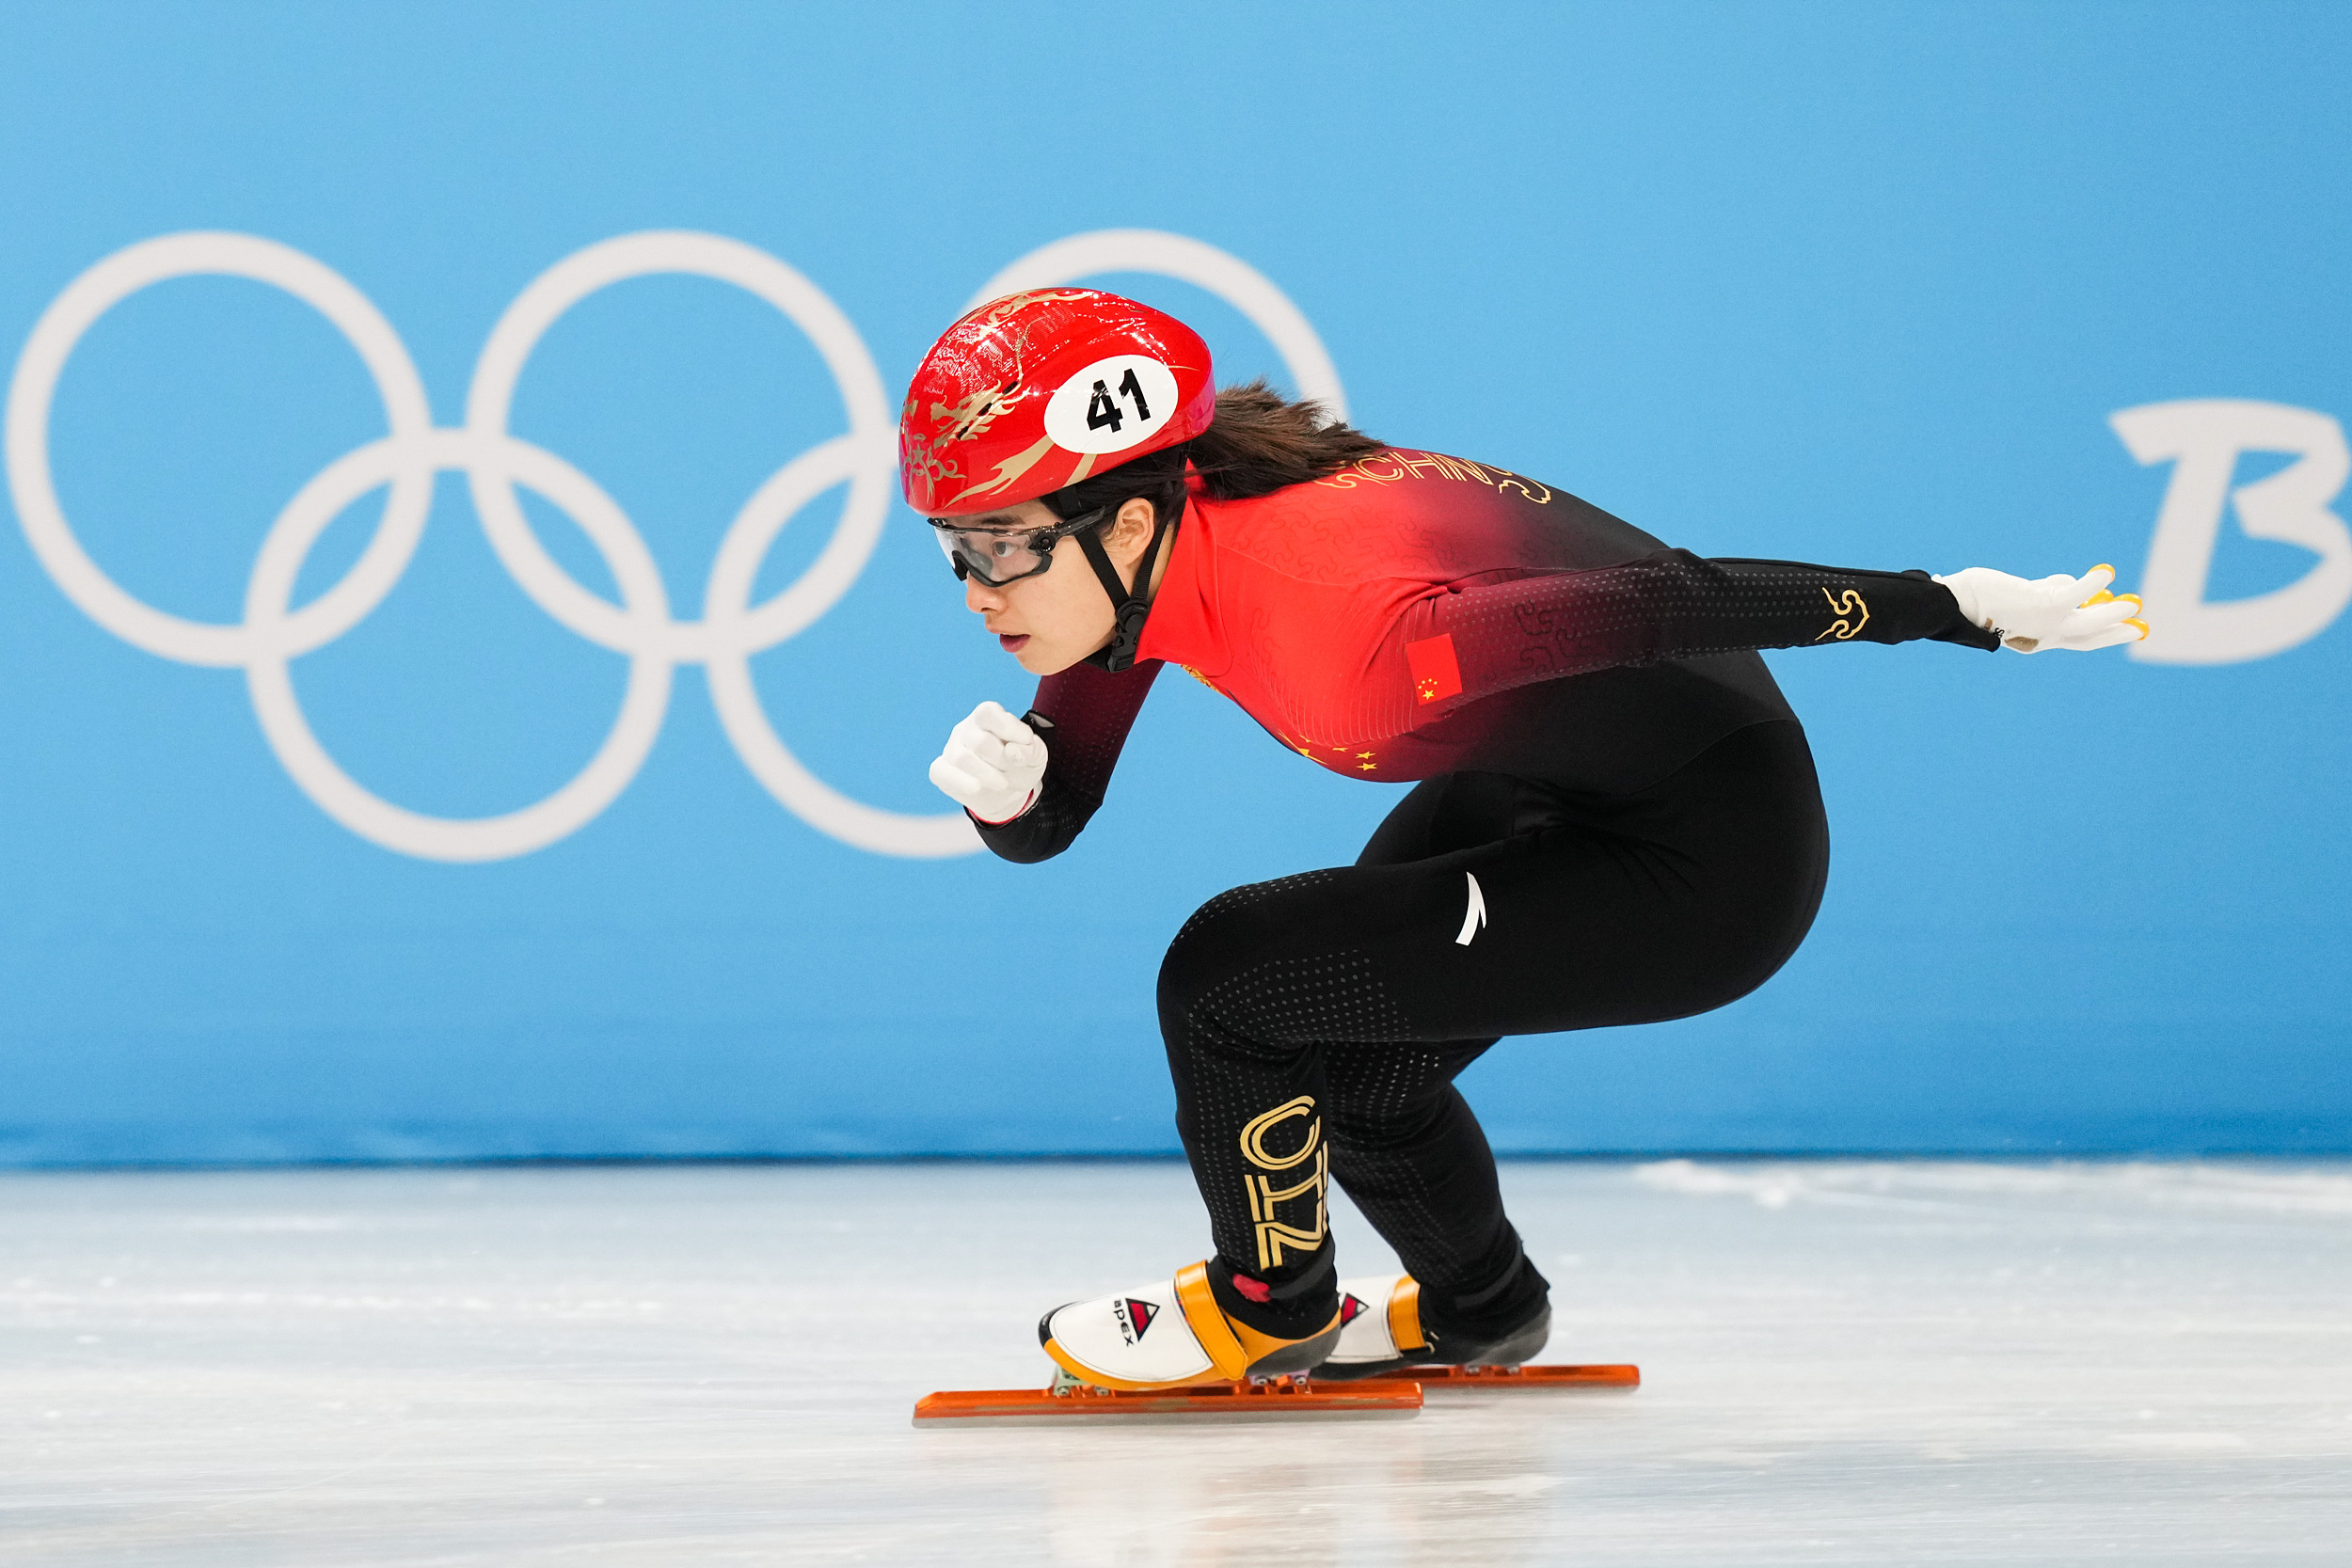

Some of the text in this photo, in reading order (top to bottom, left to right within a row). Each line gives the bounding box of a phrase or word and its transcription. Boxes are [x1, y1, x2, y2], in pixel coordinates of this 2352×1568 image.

[1087, 368, 1151, 433] 41
[1353, 451, 1494, 485] CHN
[2108, 398, 2352, 665] B
[1240, 1095, 1328, 1271] CHN
